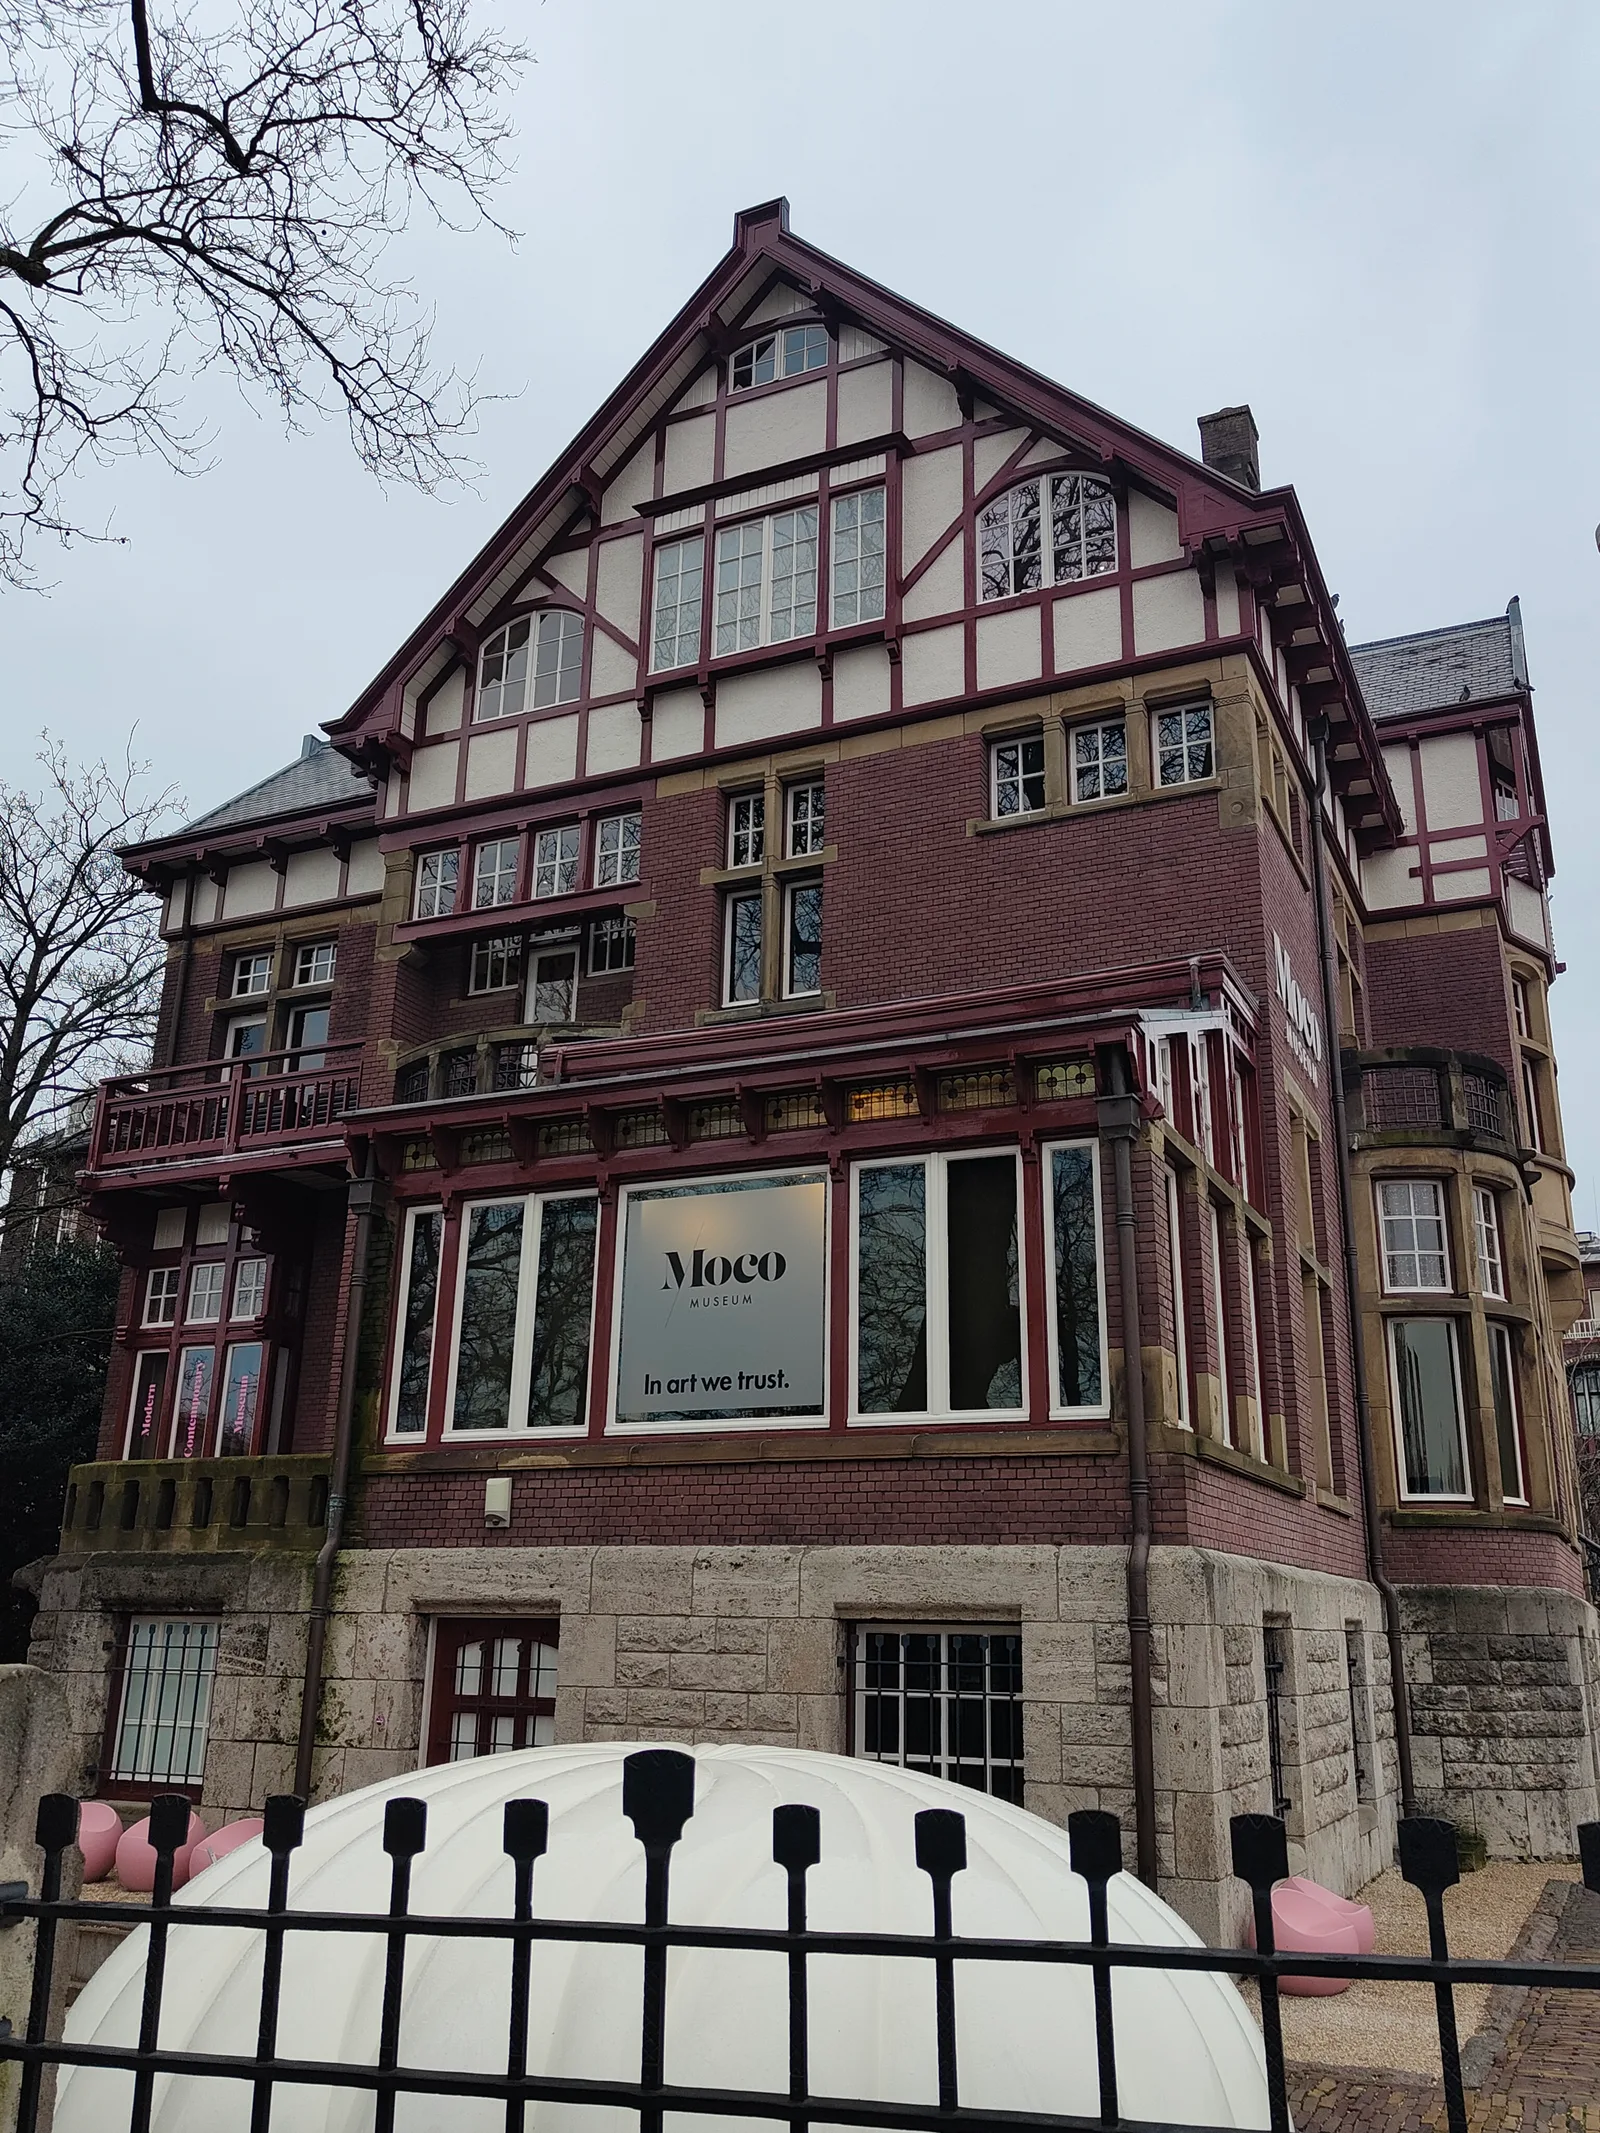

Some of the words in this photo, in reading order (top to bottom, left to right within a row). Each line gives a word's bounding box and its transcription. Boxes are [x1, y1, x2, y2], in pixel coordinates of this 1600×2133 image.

[1273, 930, 1322, 1062] Moco
[1284, 1020, 1319, 1088] MUSEUM
[660, 1248, 787, 1290] Moco
[689, 1294, 752, 1308] MUSEUM
[140, 1383, 157, 1436] Modern
[183, 1359, 206, 1458] Contemporary
[233, 1375, 249, 1434] Museum
[644, 1373, 662, 1395] In
[666, 1373, 697, 1393] art
[701, 1375, 732, 1391] we
[737, 1369, 790, 1390] trust.
